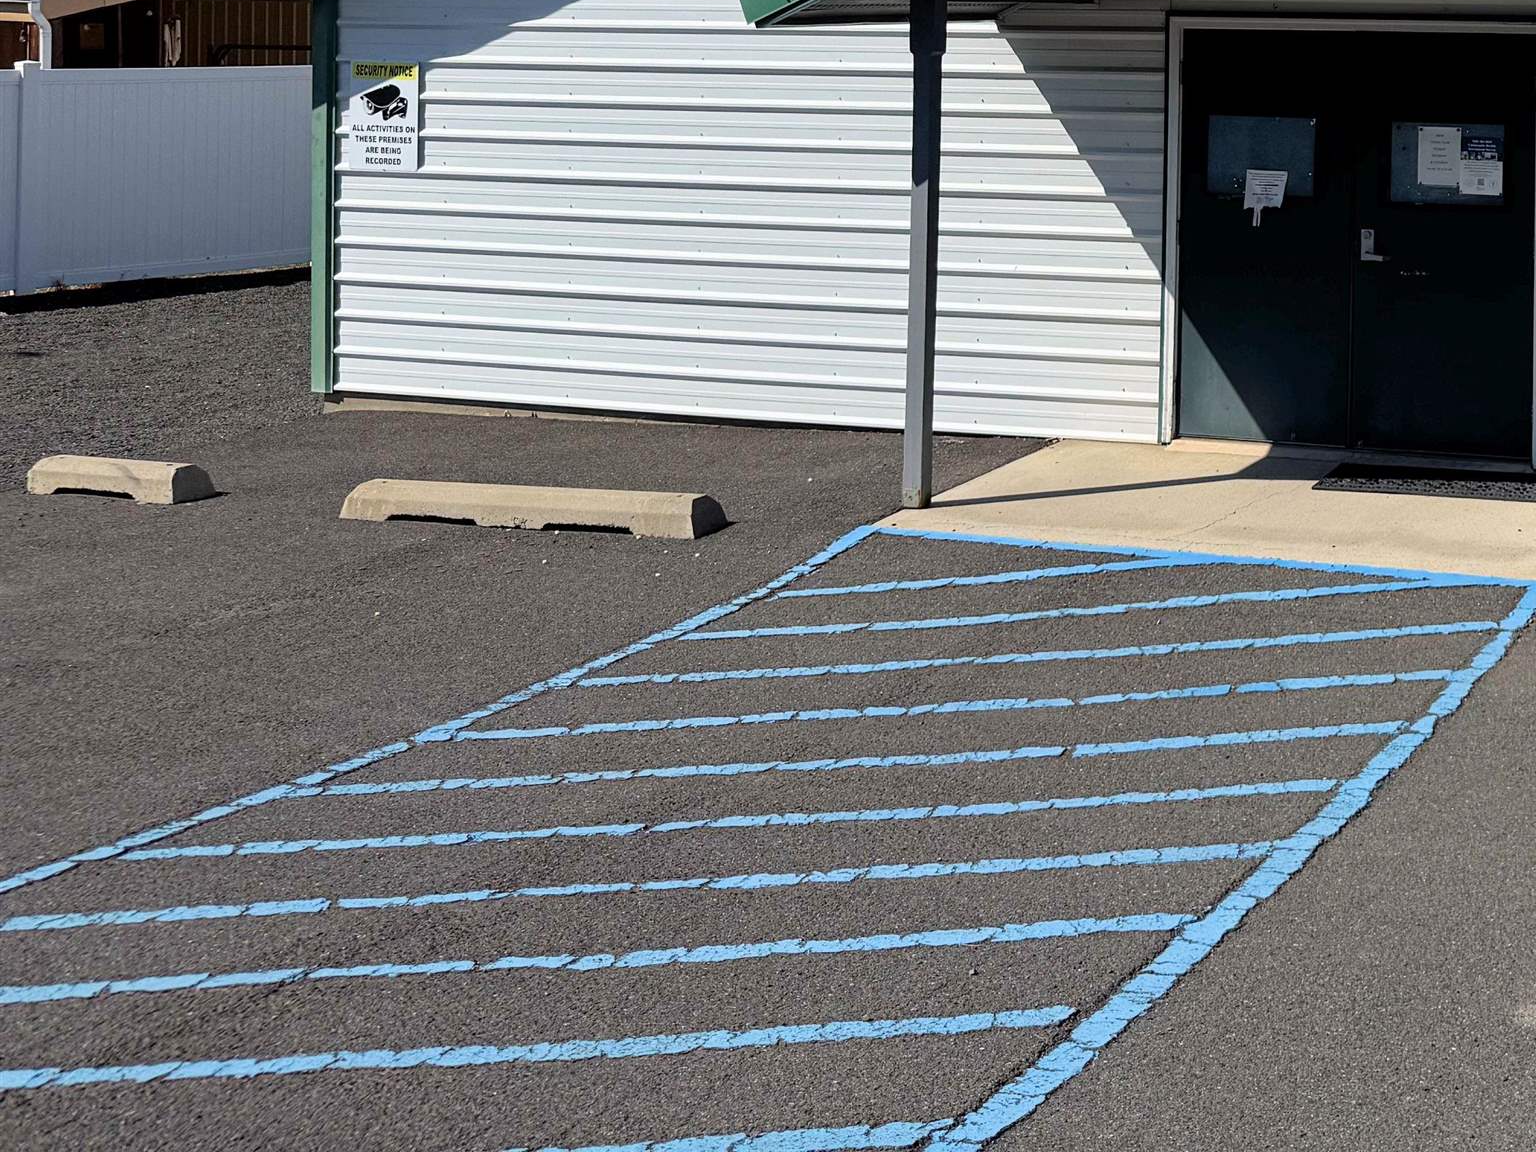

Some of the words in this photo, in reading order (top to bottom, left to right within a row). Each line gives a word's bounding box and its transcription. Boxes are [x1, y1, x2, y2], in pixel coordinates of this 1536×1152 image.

[355, 64, 388, 77] SECURITY
[389, 64, 413, 77] NOTICE
[352, 124, 365, 132] ALL
[366, 124, 403, 133] ACTIVITIES
[405, 126, 416, 134] ON
[355, 135, 377, 143] THESE
[378, 136, 412, 144] PREMISES
[365, 146, 379, 154] ARE
